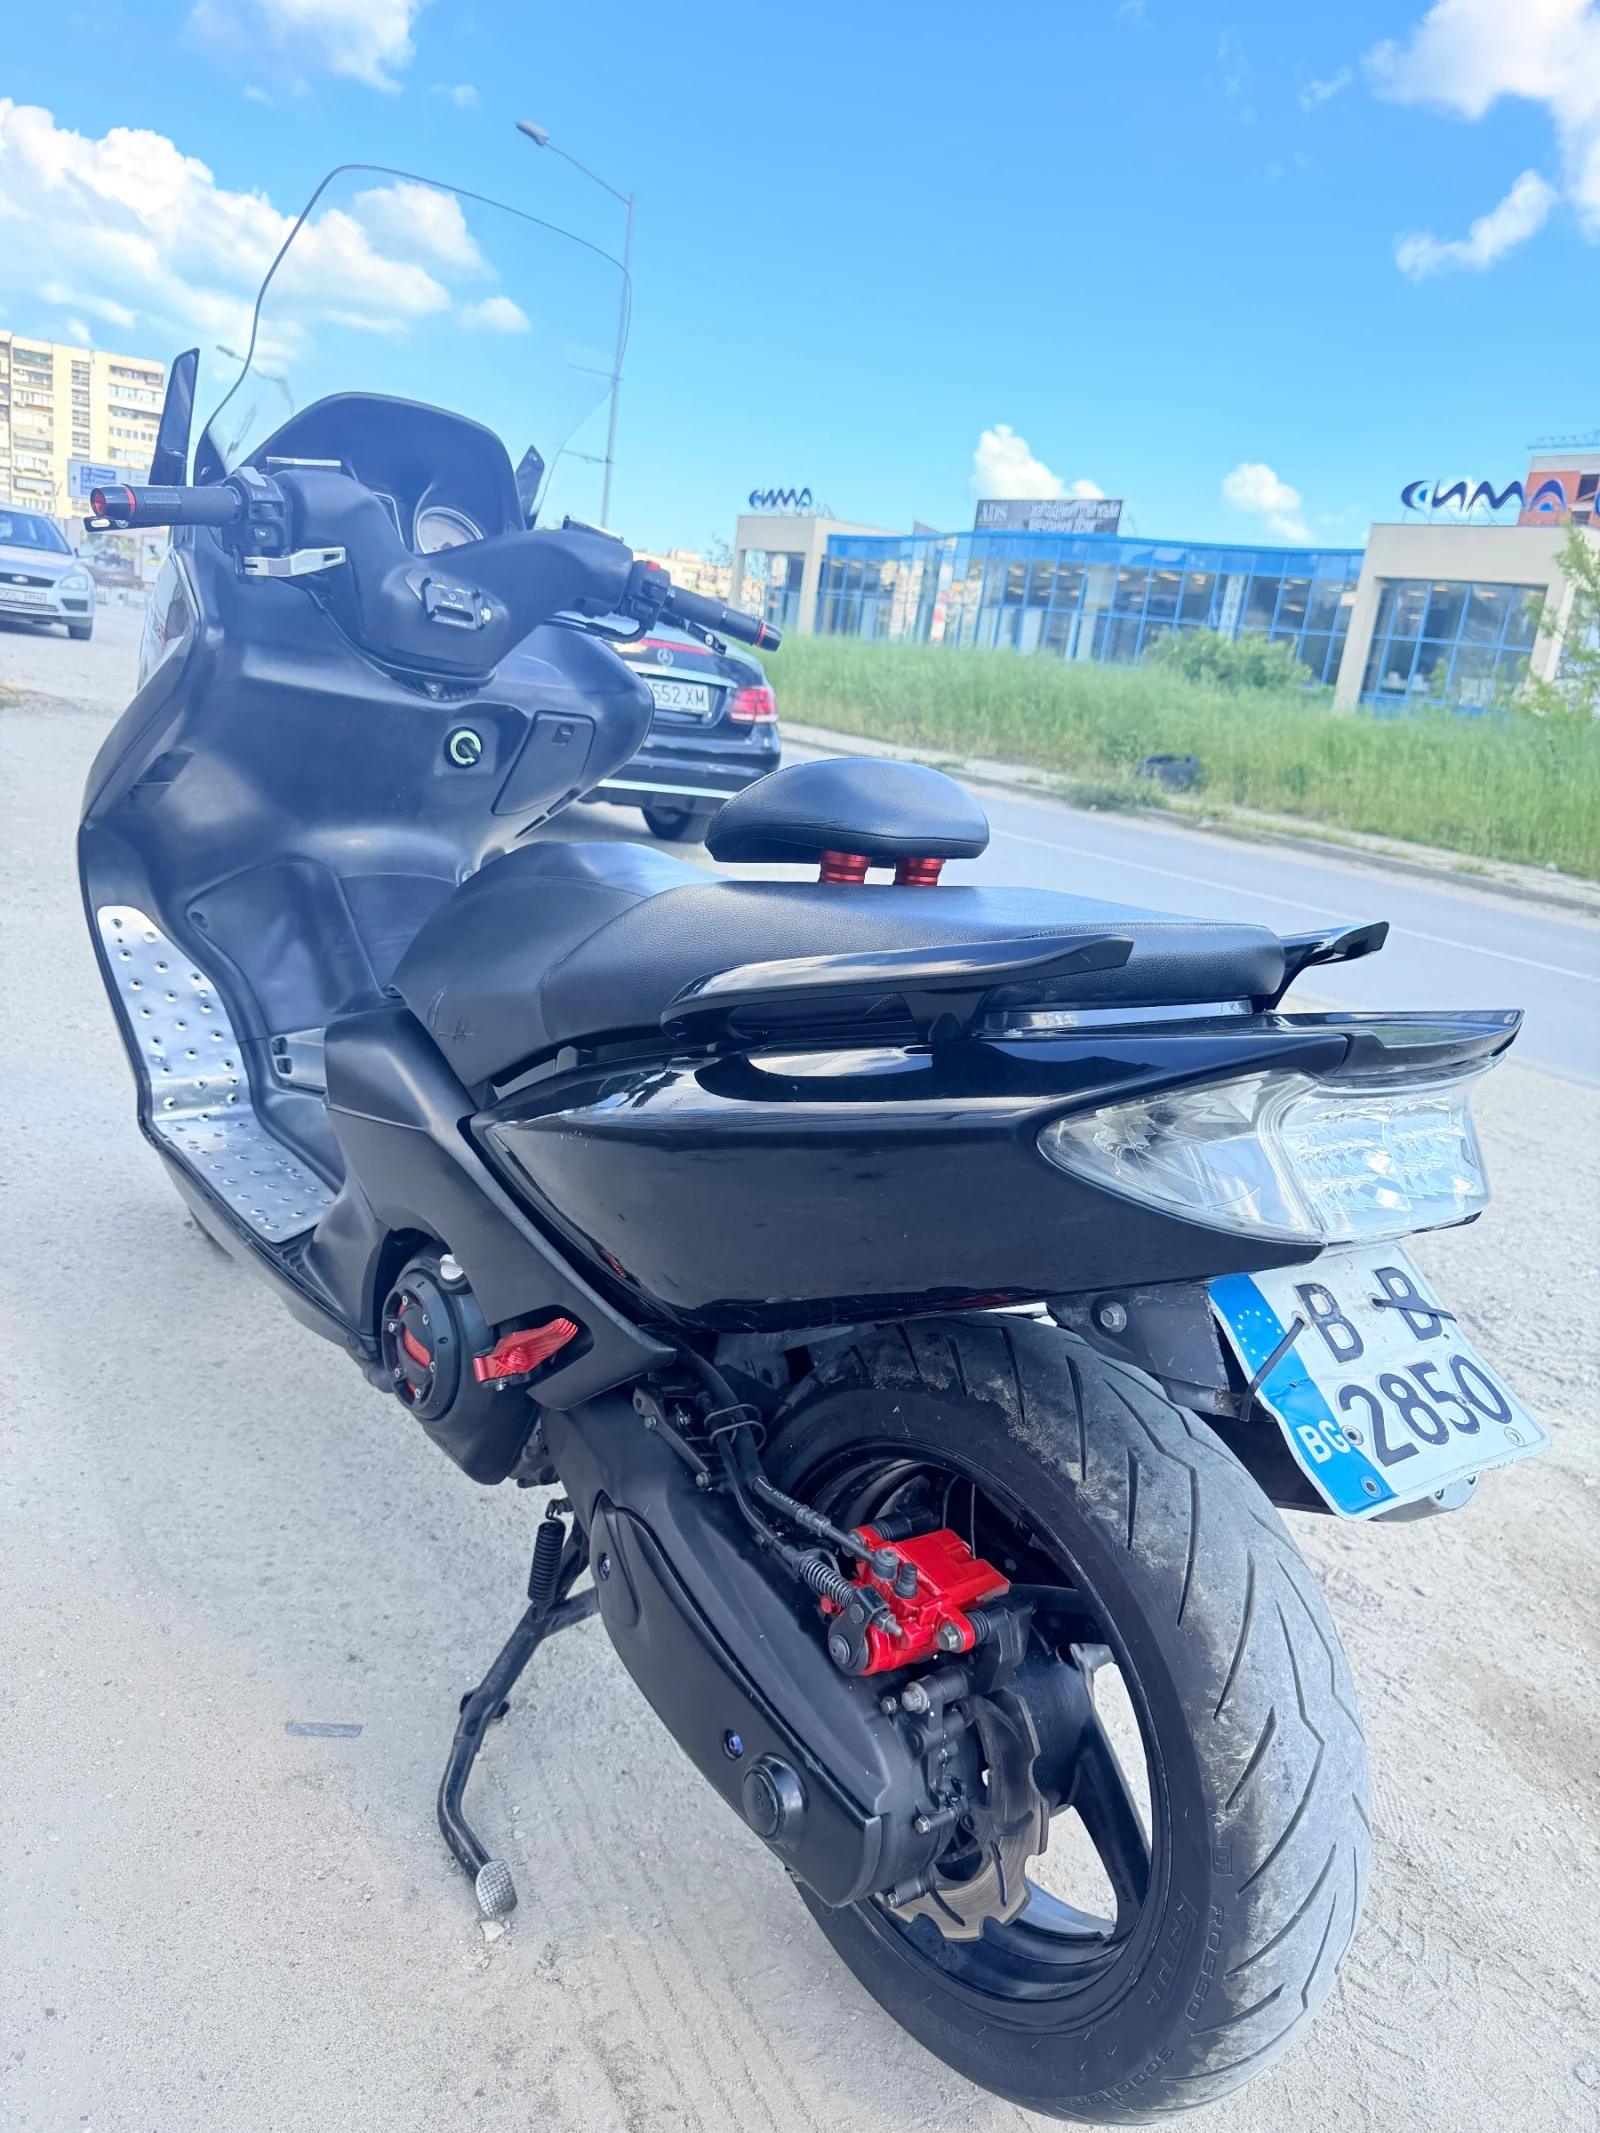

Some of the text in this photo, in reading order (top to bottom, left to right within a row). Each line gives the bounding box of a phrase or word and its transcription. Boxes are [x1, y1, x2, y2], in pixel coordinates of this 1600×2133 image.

[1294, 1282, 1364, 1364] B
[1296, 1419, 1351, 1464] BG
[1338, 1354, 1512, 1468] 2850
